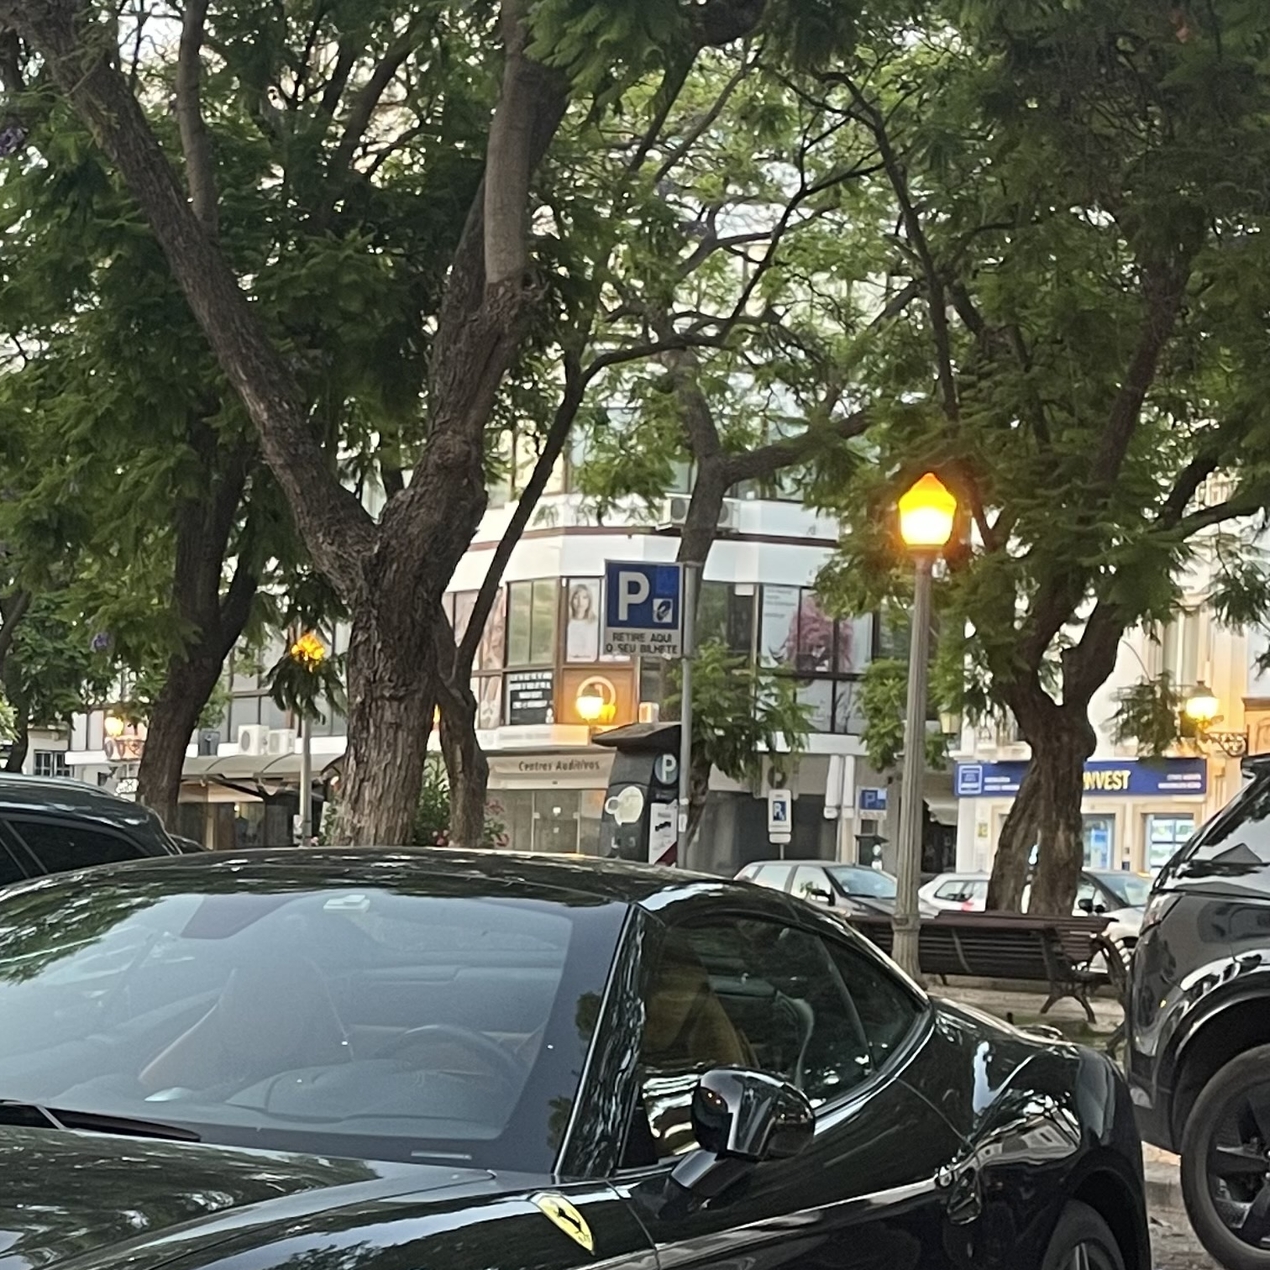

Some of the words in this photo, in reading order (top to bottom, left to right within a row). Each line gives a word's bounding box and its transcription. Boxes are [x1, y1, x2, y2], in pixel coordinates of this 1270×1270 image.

[618, 571, 650, 621] P
[612, 632, 646, 643] RETIRE
[650, 633, 673, 643] AQUI
[605, 643, 614, 653] O
[617, 643, 637, 653] SEU
[639, 644, 678, 654] BILHETE
[661, 753, 677, 783] P
